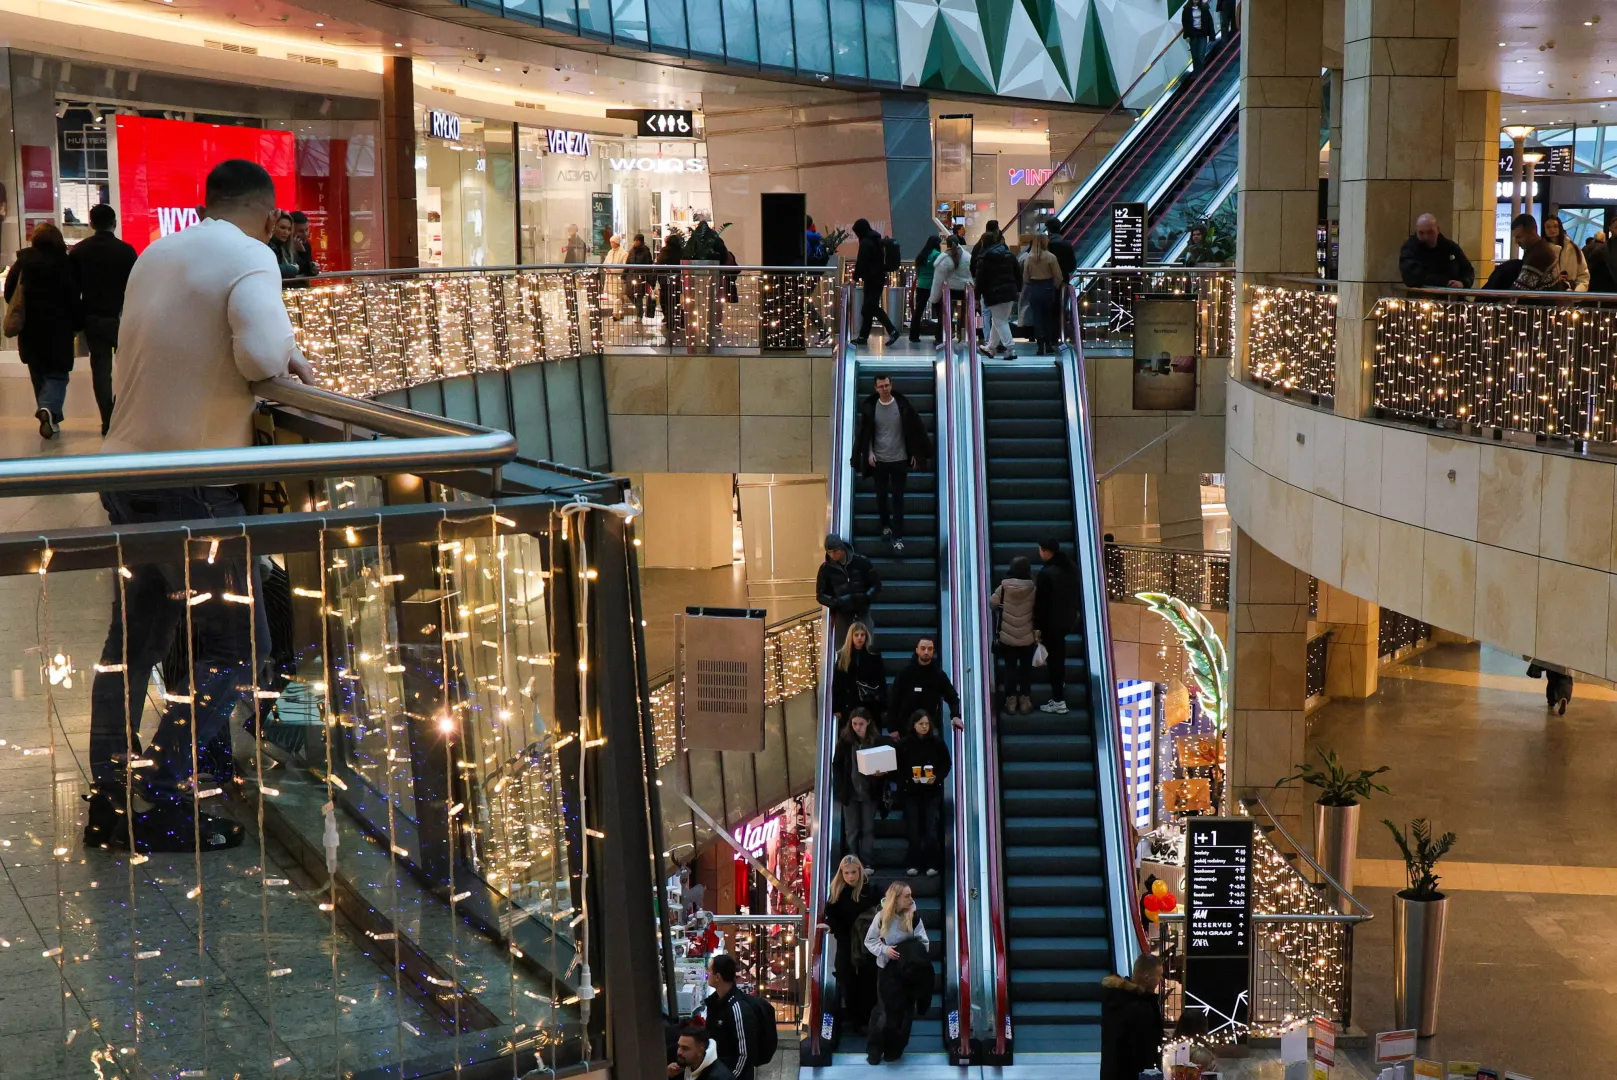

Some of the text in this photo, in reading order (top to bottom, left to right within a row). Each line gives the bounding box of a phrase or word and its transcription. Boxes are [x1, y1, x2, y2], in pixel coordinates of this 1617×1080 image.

[433, 111, 460, 140] RYŁKO
[547, 128, 591, 157] VENEZIA
[1192, 938, 1210, 947] ZARA
